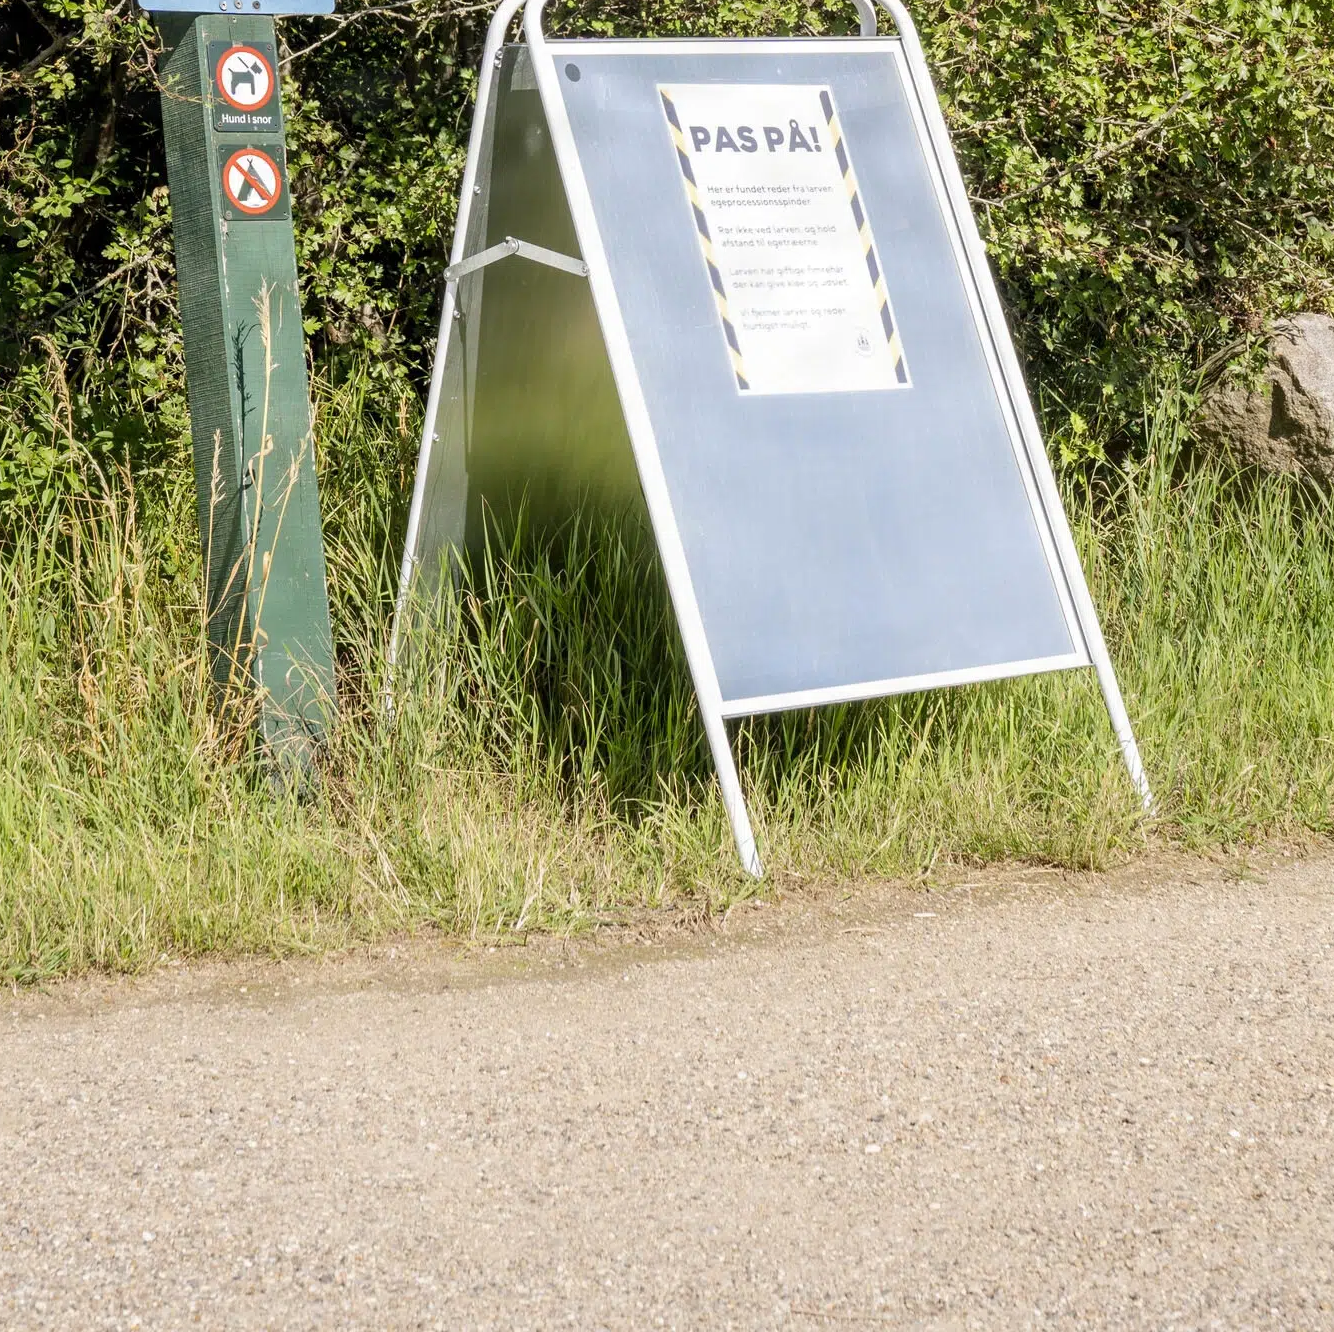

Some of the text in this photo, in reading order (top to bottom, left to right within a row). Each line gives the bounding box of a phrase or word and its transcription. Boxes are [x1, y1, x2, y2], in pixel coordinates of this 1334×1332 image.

[221, 113, 272, 124] Hund i snor
[689, 118, 822, 153] PAS PÅ!
[707, 184, 723, 194] Her
[725, 185, 734, 194] er
[736, 184, 766, 194] fundet
